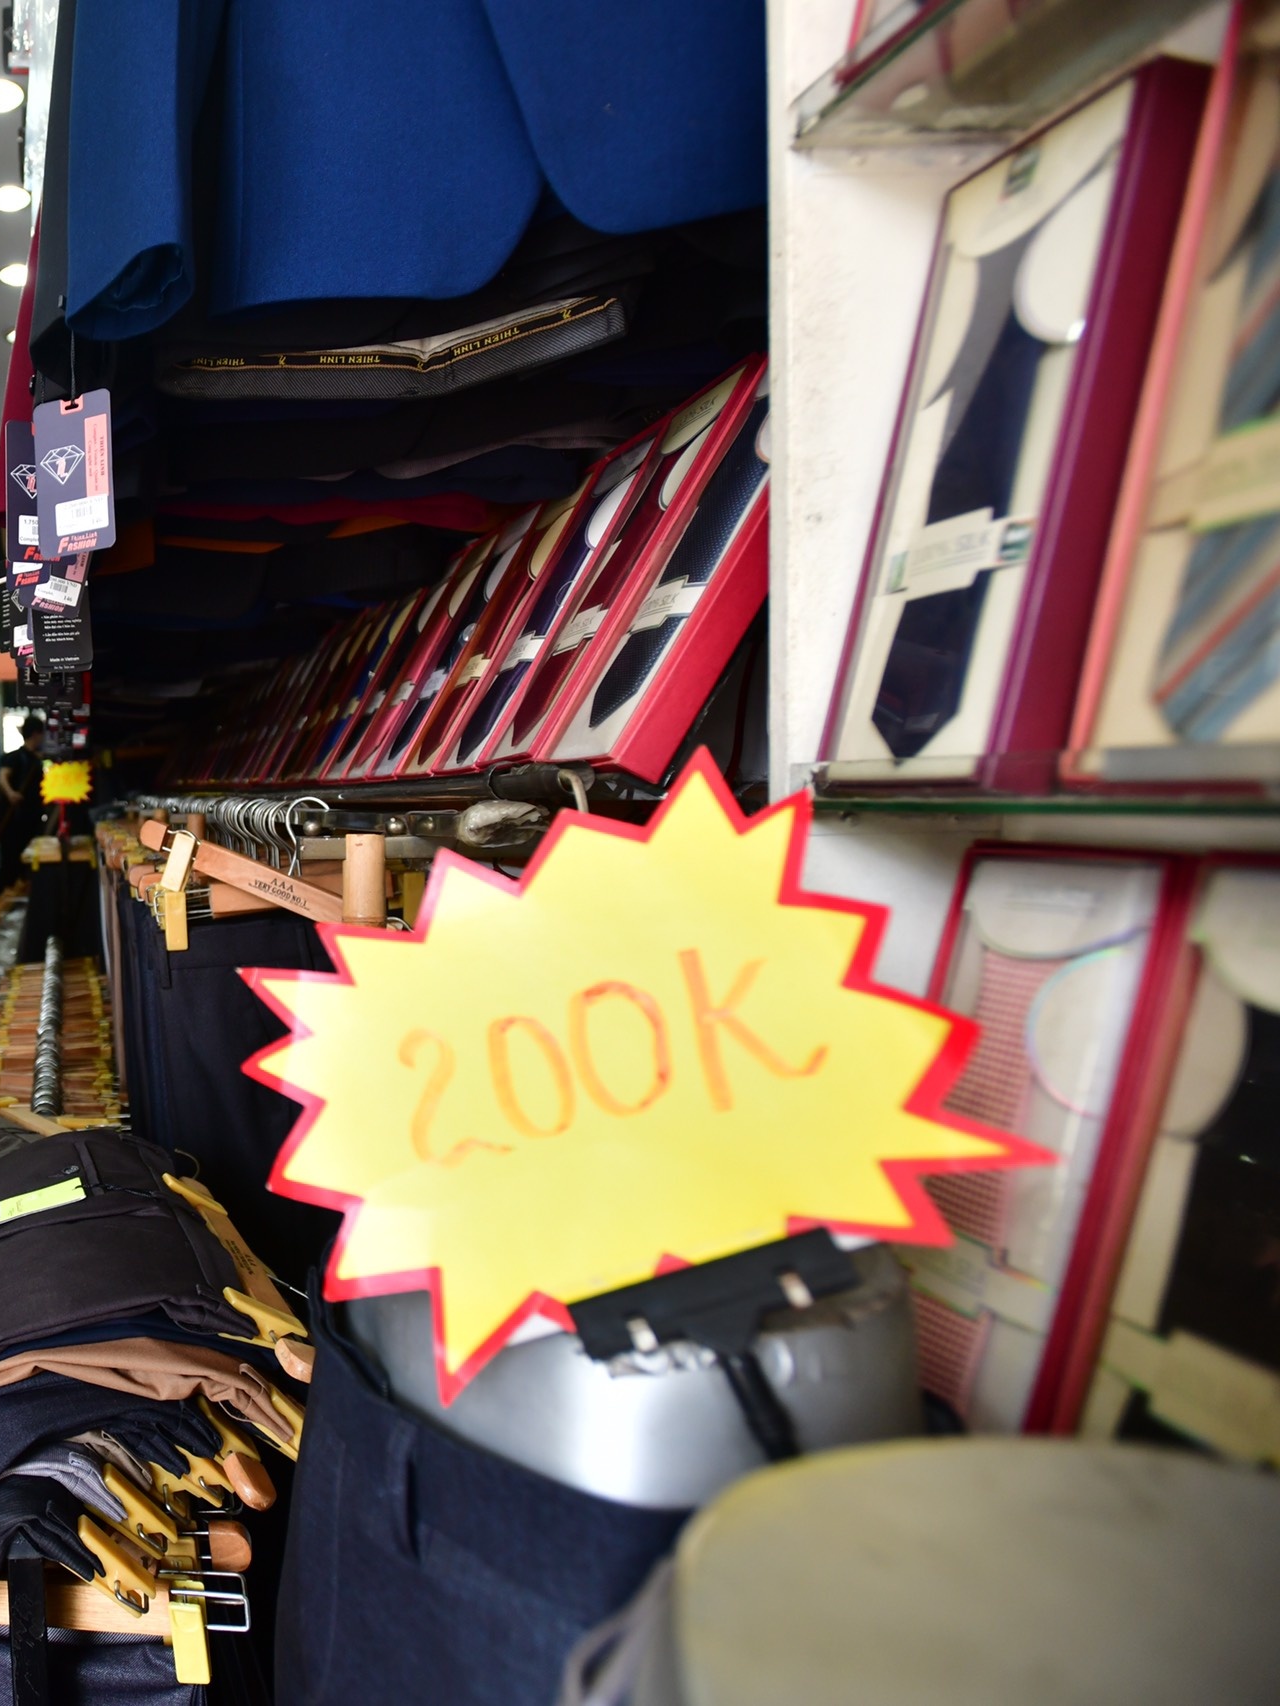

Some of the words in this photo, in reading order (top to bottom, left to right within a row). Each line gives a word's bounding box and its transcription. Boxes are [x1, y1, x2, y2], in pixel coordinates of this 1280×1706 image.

[484, 327, 520, 346] THIEN
[453, 340, 481, 357] LINH
[216, 357, 245, 367] THIEN
[319, 356, 345, 364] LINH
[348, 356, 381, 364] THIEN
[254, 879, 271, 894] VERY
[271, 886, 291, 900] GOOD
[292, 895, 308, 907] NO.1
[397, 947, 830, 1168] 200K
